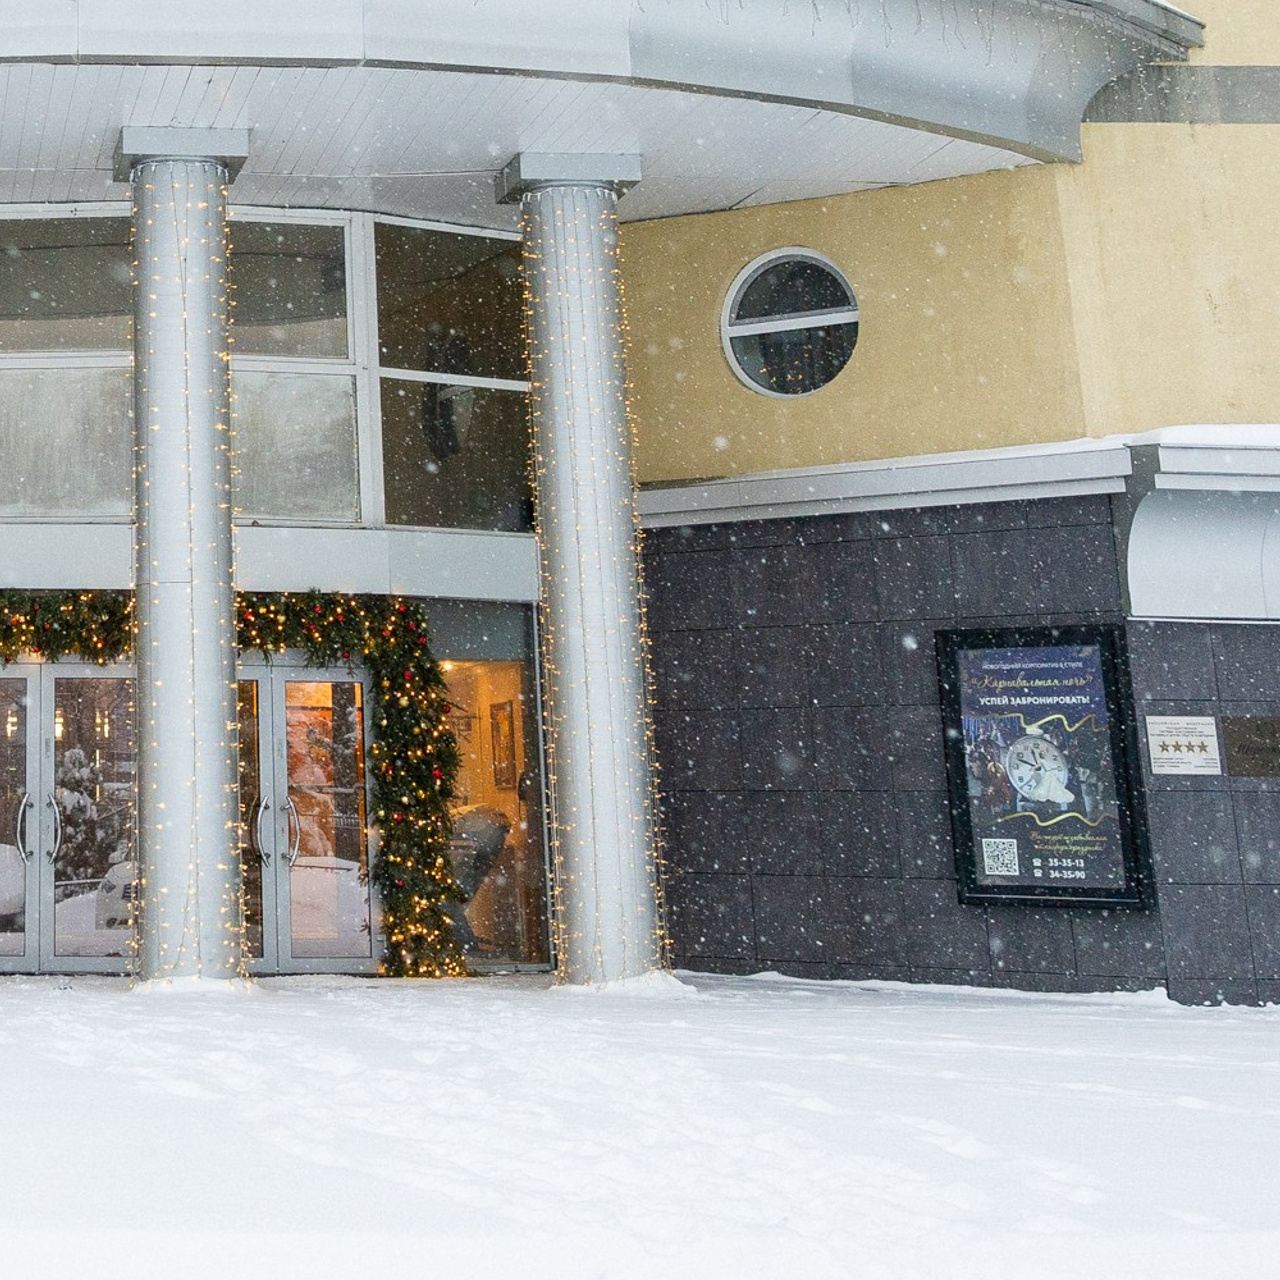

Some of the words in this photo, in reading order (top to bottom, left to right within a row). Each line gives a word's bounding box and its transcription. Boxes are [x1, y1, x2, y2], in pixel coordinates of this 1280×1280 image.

[979, 696, 1009, 706] УСПЕЙ
[1010, 696, 1090, 706] ЗАБРОНИРОВАТЬ!
[1048, 858, 1085, 867] 35-35-13
[1049, 870, 1086, 879] 34-35-90
